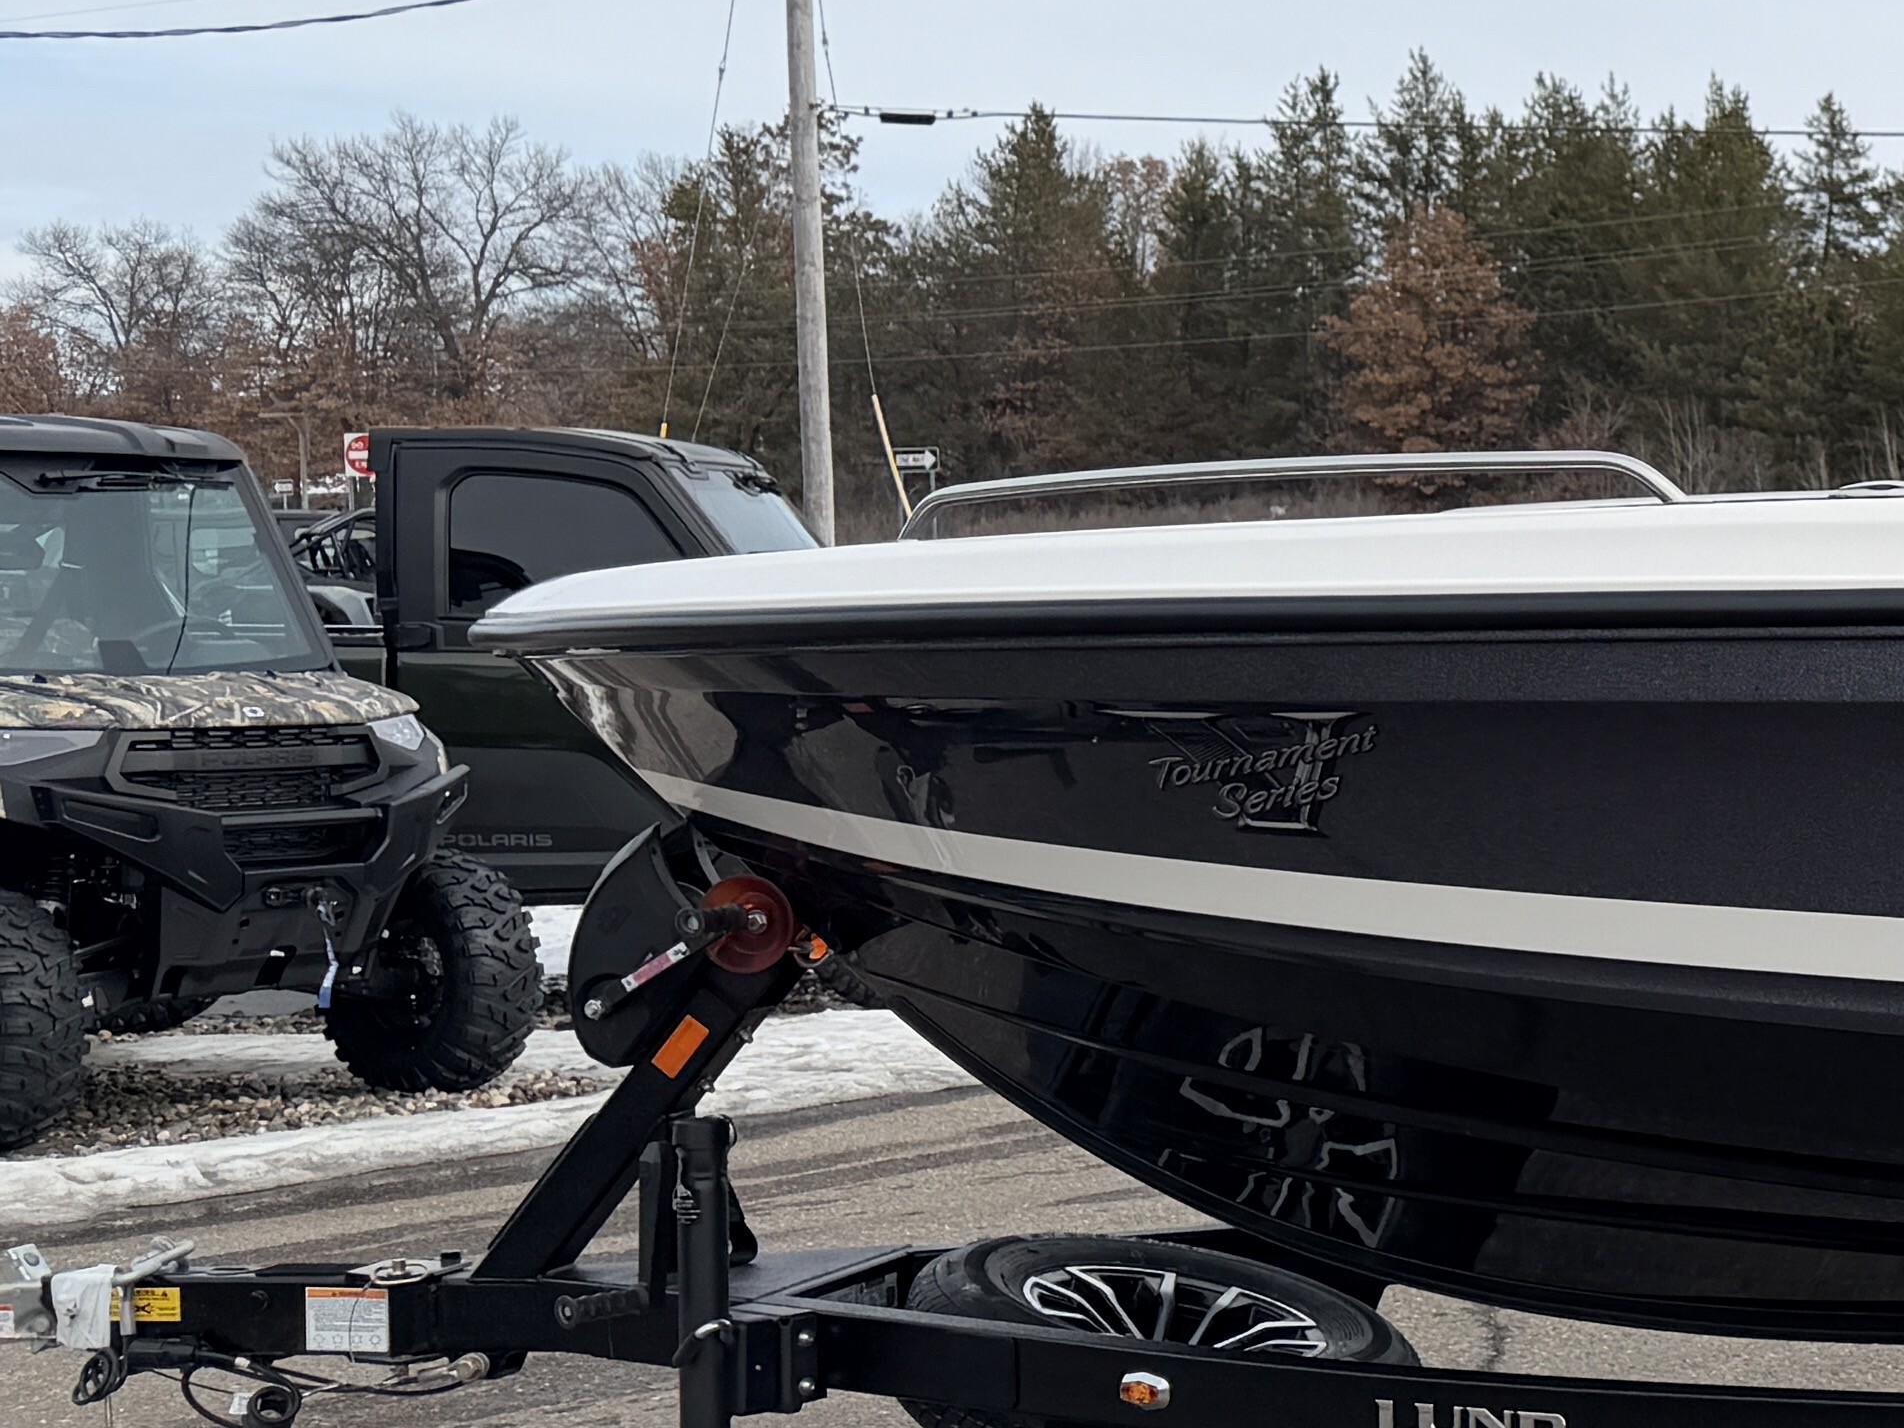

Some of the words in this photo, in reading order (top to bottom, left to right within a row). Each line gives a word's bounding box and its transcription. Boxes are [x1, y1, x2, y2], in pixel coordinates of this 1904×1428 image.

[1148, 724, 1378, 790] Tournament
[1211, 776, 1340, 819] Series
[441, 833, 554, 847] POLARIS
